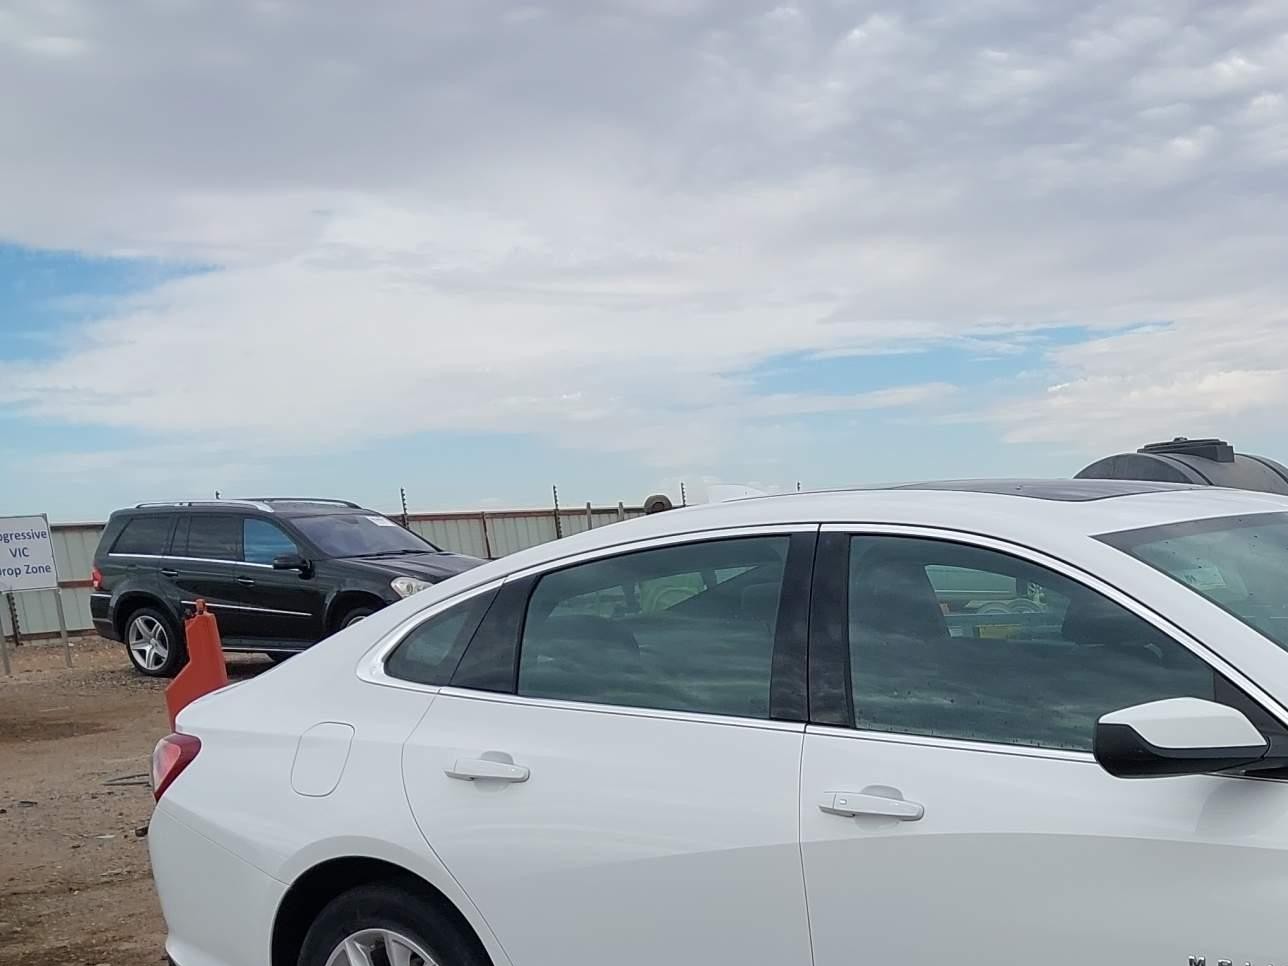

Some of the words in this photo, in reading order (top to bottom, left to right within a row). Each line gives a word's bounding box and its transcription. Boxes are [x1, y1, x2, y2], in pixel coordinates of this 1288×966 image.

[9, 547, 30, 558] VIC
[0, 567, 21, 578] rop
[24, 564, 52, 575] Zone
